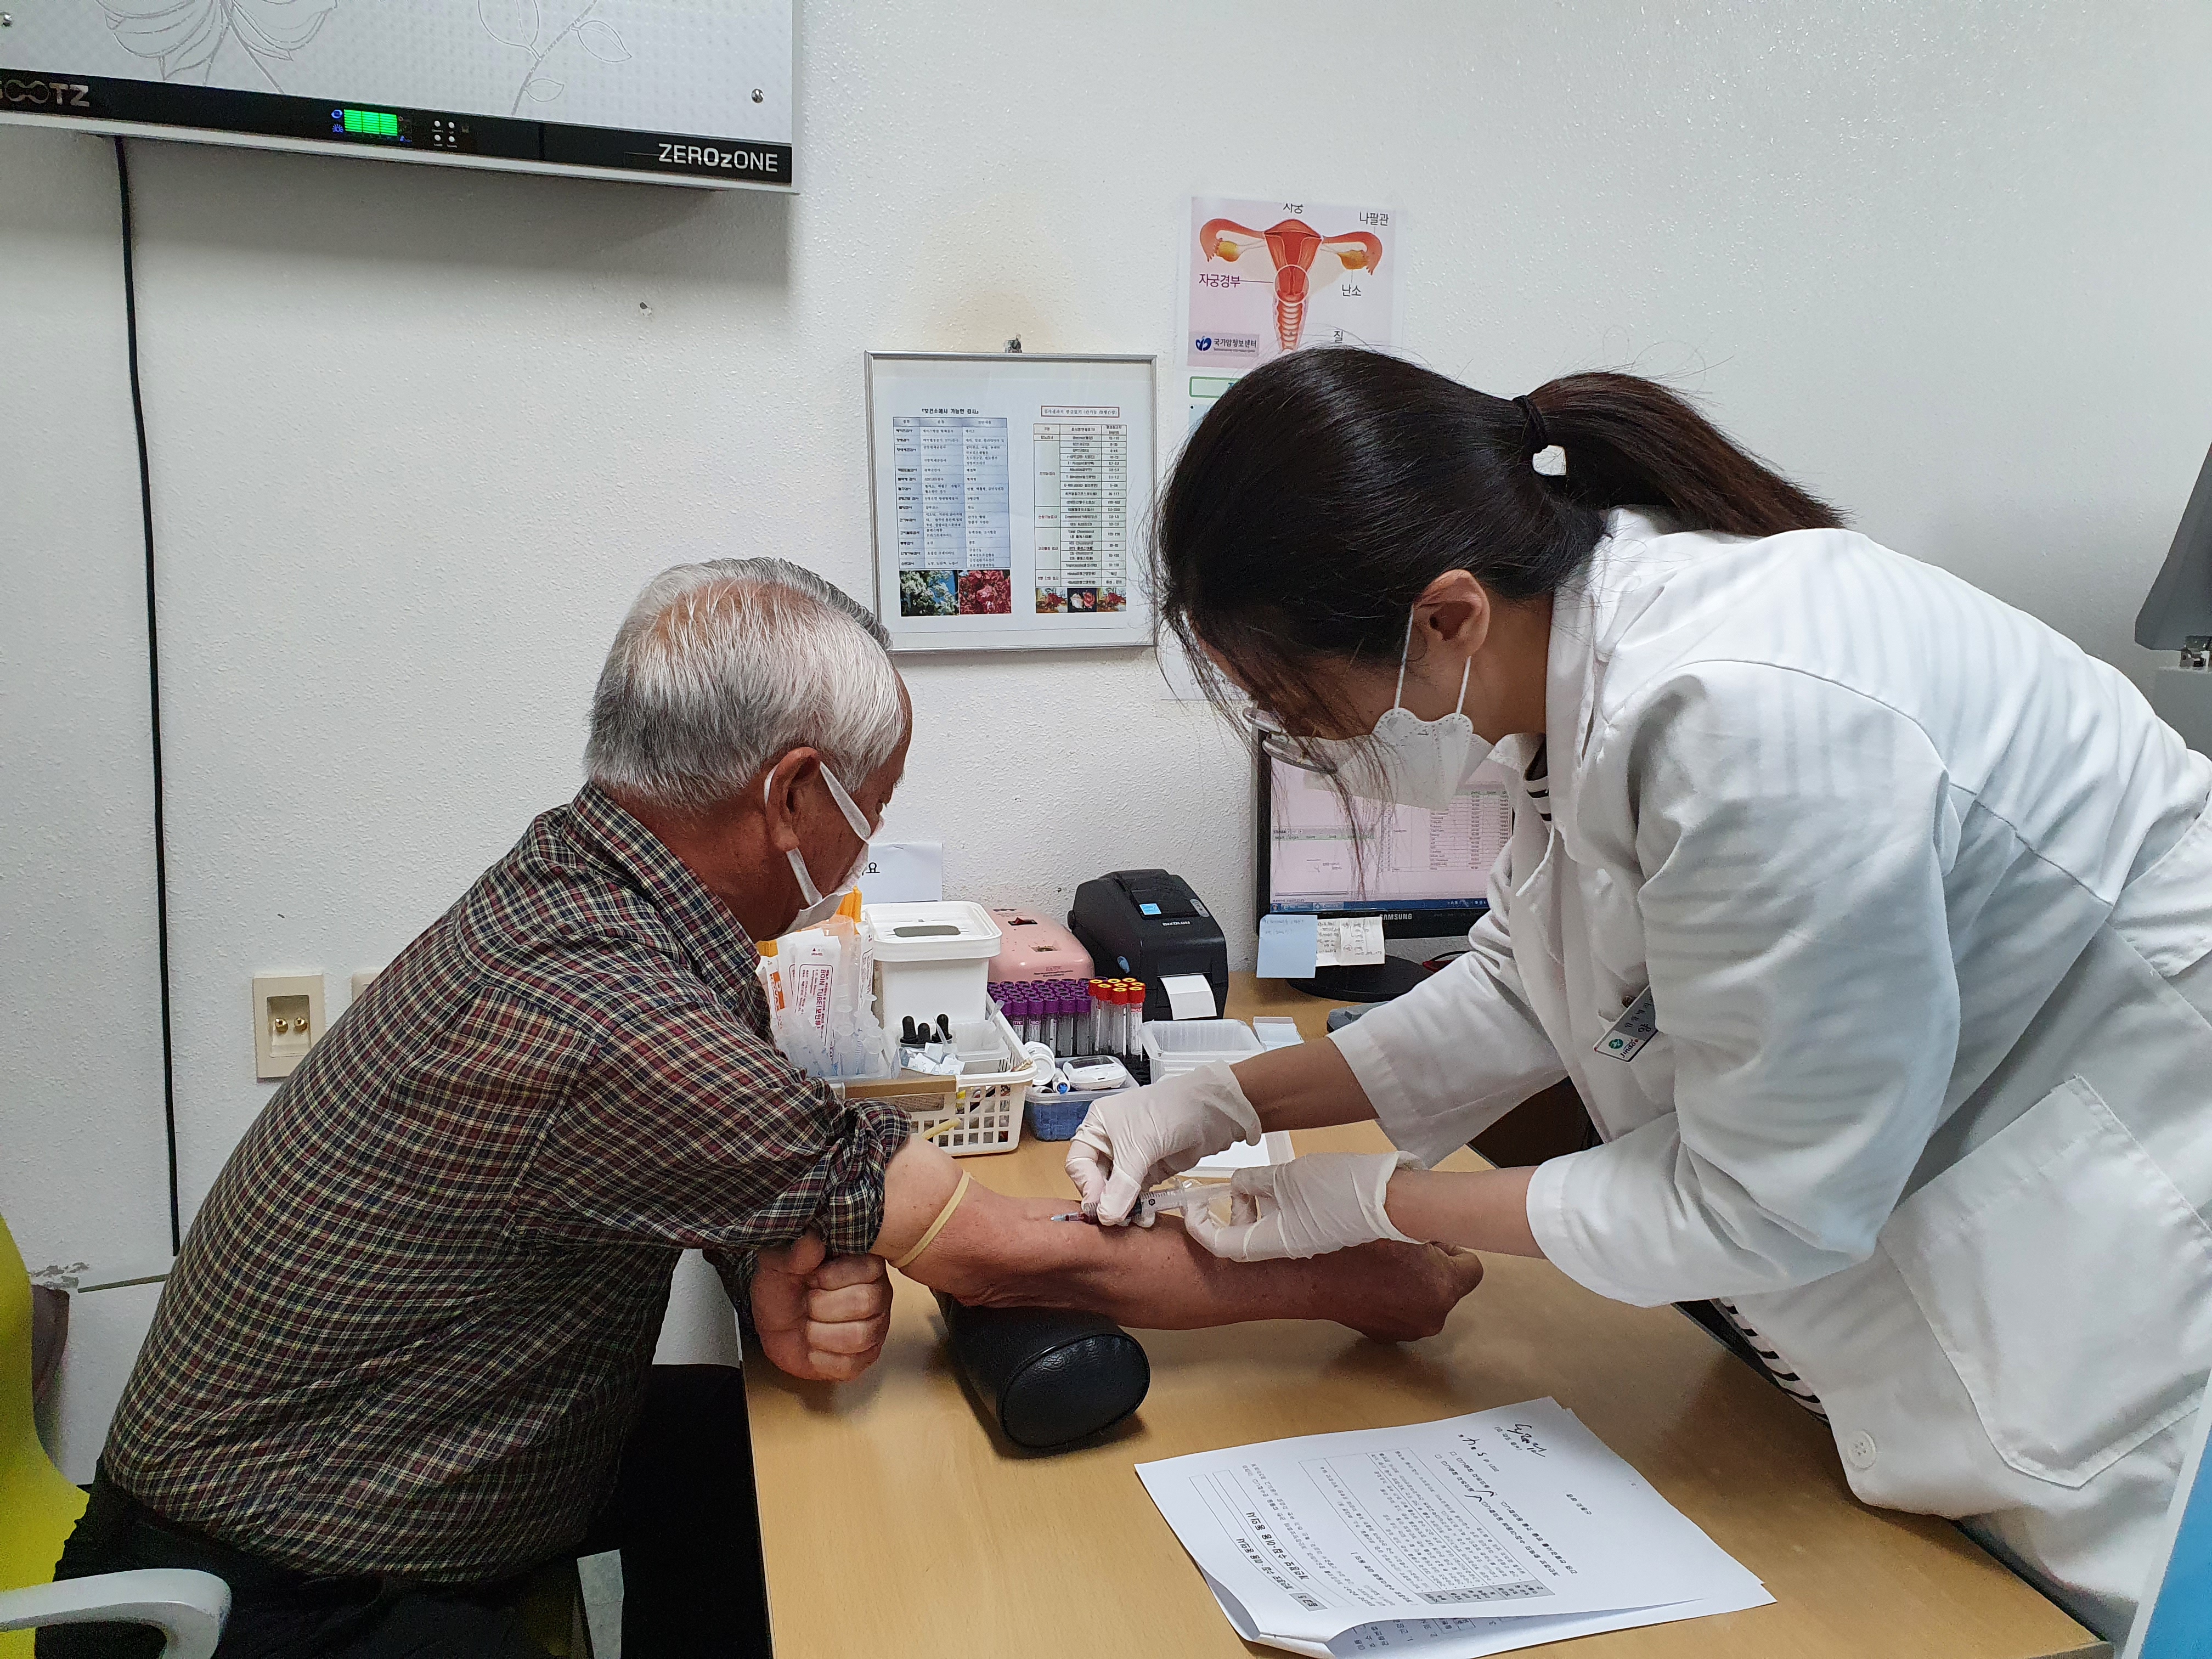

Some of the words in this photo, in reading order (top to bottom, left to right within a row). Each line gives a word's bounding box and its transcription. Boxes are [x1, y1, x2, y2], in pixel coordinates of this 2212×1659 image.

[658, 143, 778, 173] ZEROzONE
[1198, 273, 1241, 288] 자궁경부
[1342, 284, 1362, 297] 난소
[1334, 331, 1344, 344] 질
[1245, 1512, 1266, 1531] 동의서
[1284, 1561, 1309, 1579] 개인정보
